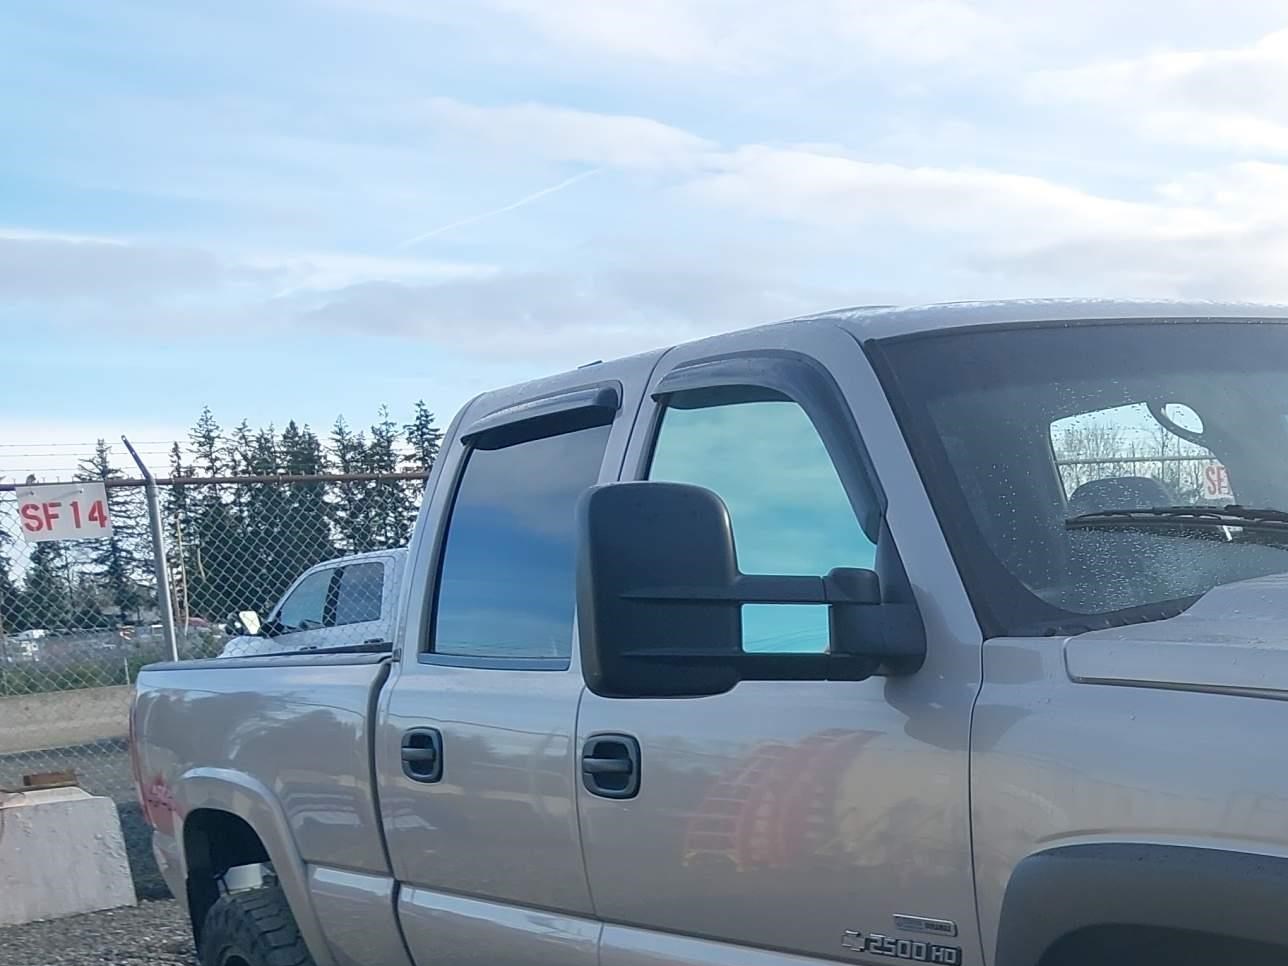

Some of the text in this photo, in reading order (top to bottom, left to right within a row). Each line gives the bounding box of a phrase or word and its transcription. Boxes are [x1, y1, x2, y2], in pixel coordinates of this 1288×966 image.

[21, 501, 107, 532] SF 14
[869, 933, 957, 963] 2500 HD
